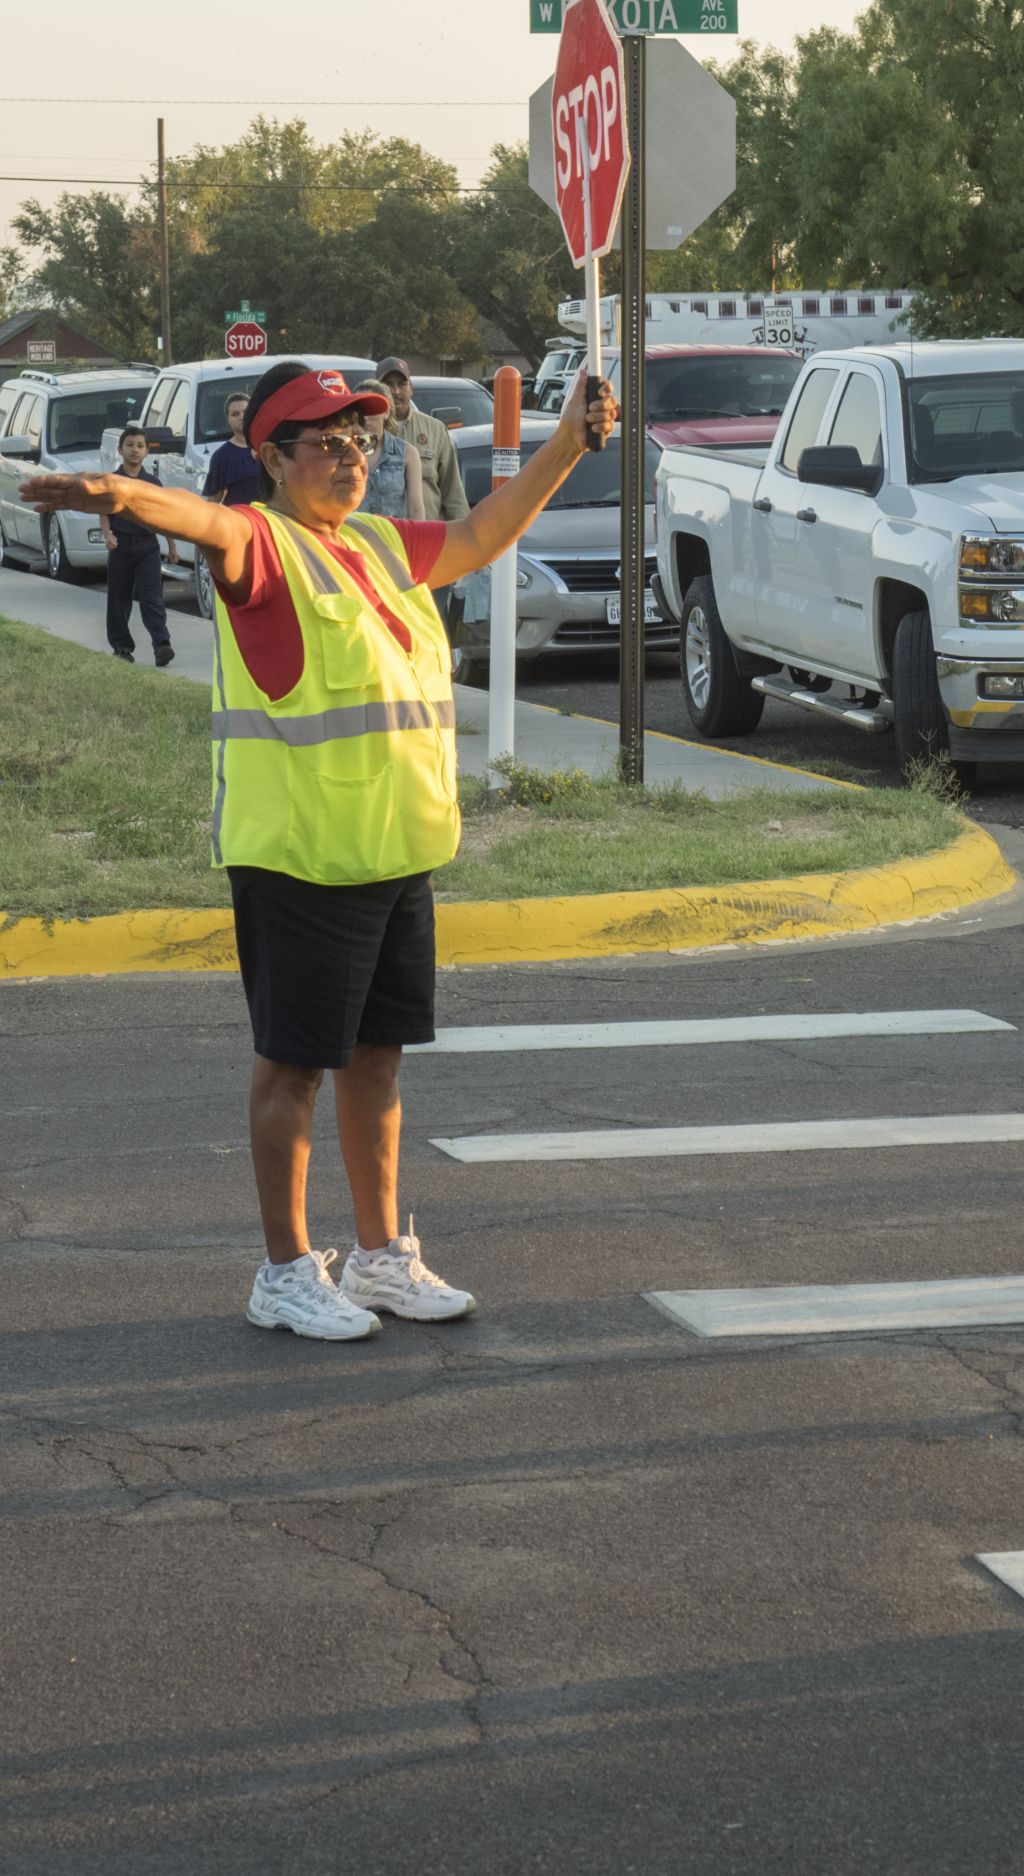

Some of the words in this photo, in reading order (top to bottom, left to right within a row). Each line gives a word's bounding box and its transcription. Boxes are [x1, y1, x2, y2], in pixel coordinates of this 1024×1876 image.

[539, 4, 553, 22] W
[702, 0, 725, 11] AVE
[700, 15, 726, 30] 200
[556, 65, 618, 190] STOP
[232, 312, 256, 322] Florida
[228, 335, 264, 351] STOP
[767, 328, 791, 343] 30
